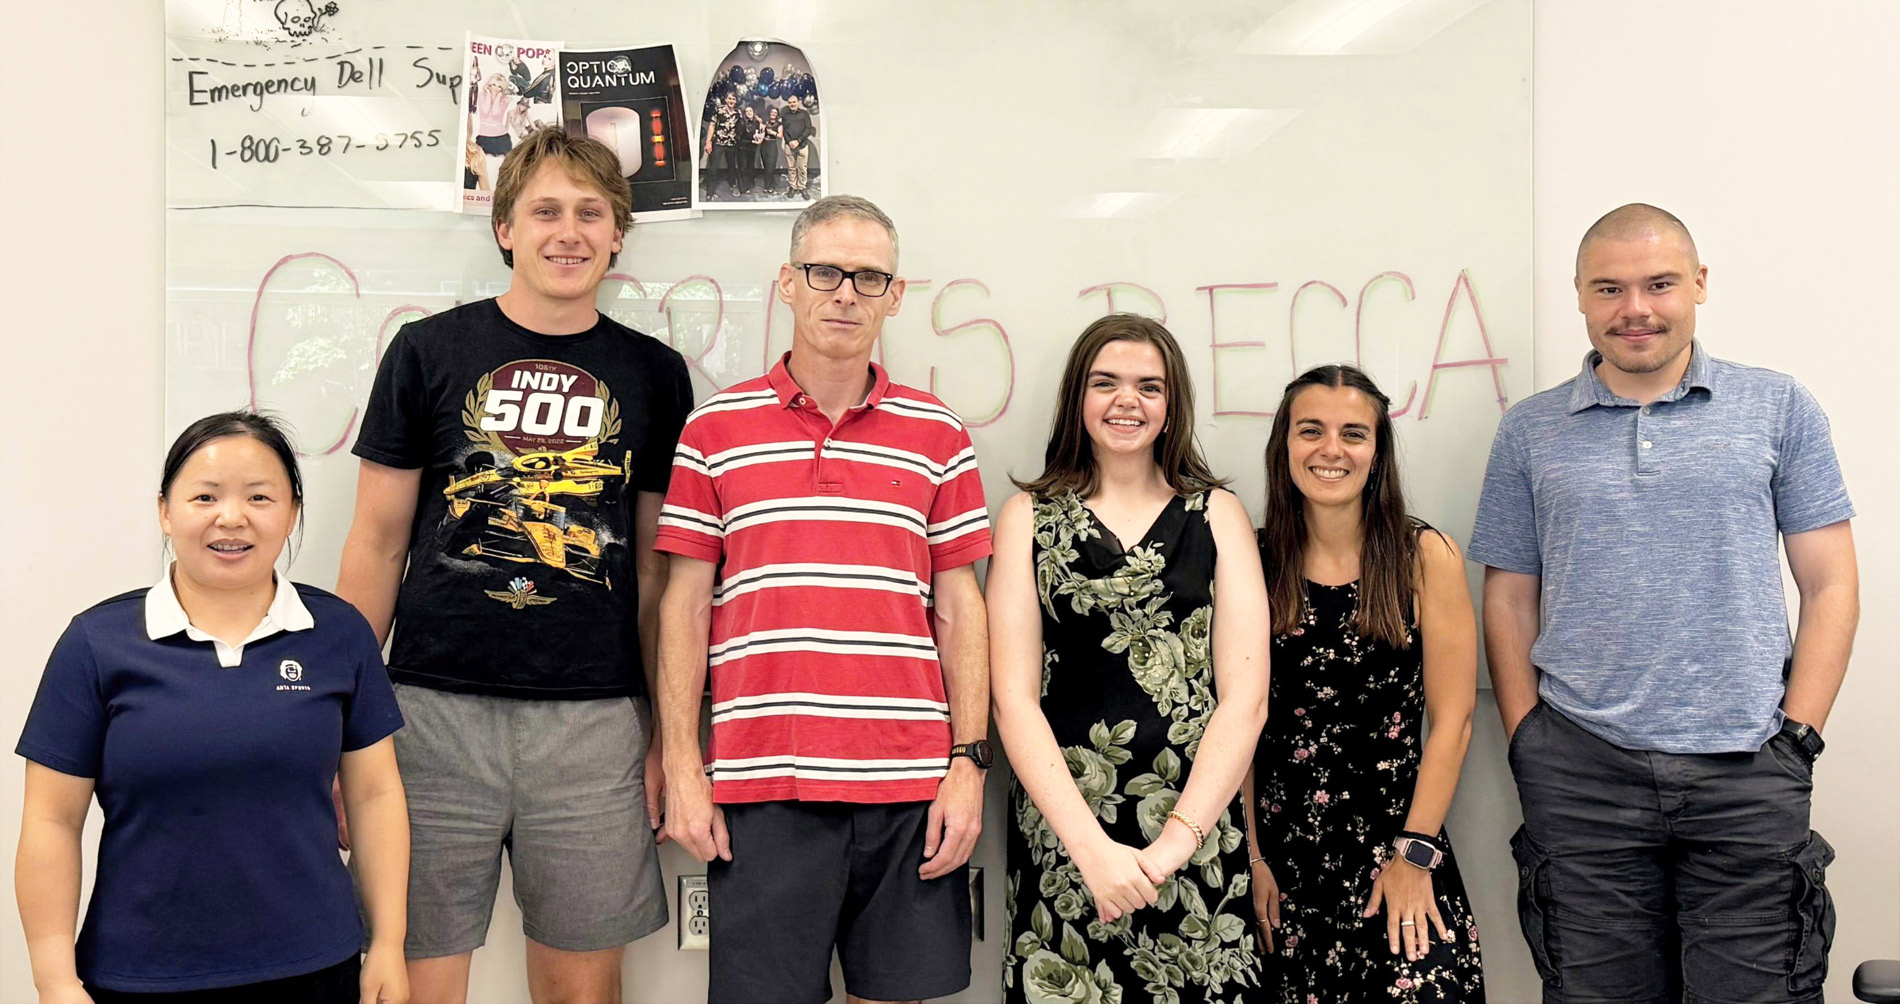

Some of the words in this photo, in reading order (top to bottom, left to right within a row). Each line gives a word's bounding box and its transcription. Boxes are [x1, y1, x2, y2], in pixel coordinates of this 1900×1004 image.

[566, 59, 632, 75] OPTICA
[188, 70, 316, 117] Emergency
[336, 57, 384, 90] Dell
[567, 71, 656, 89] QUANTUM
[511, 370, 579, 393] INDY
[480, 389, 605, 438] 500
